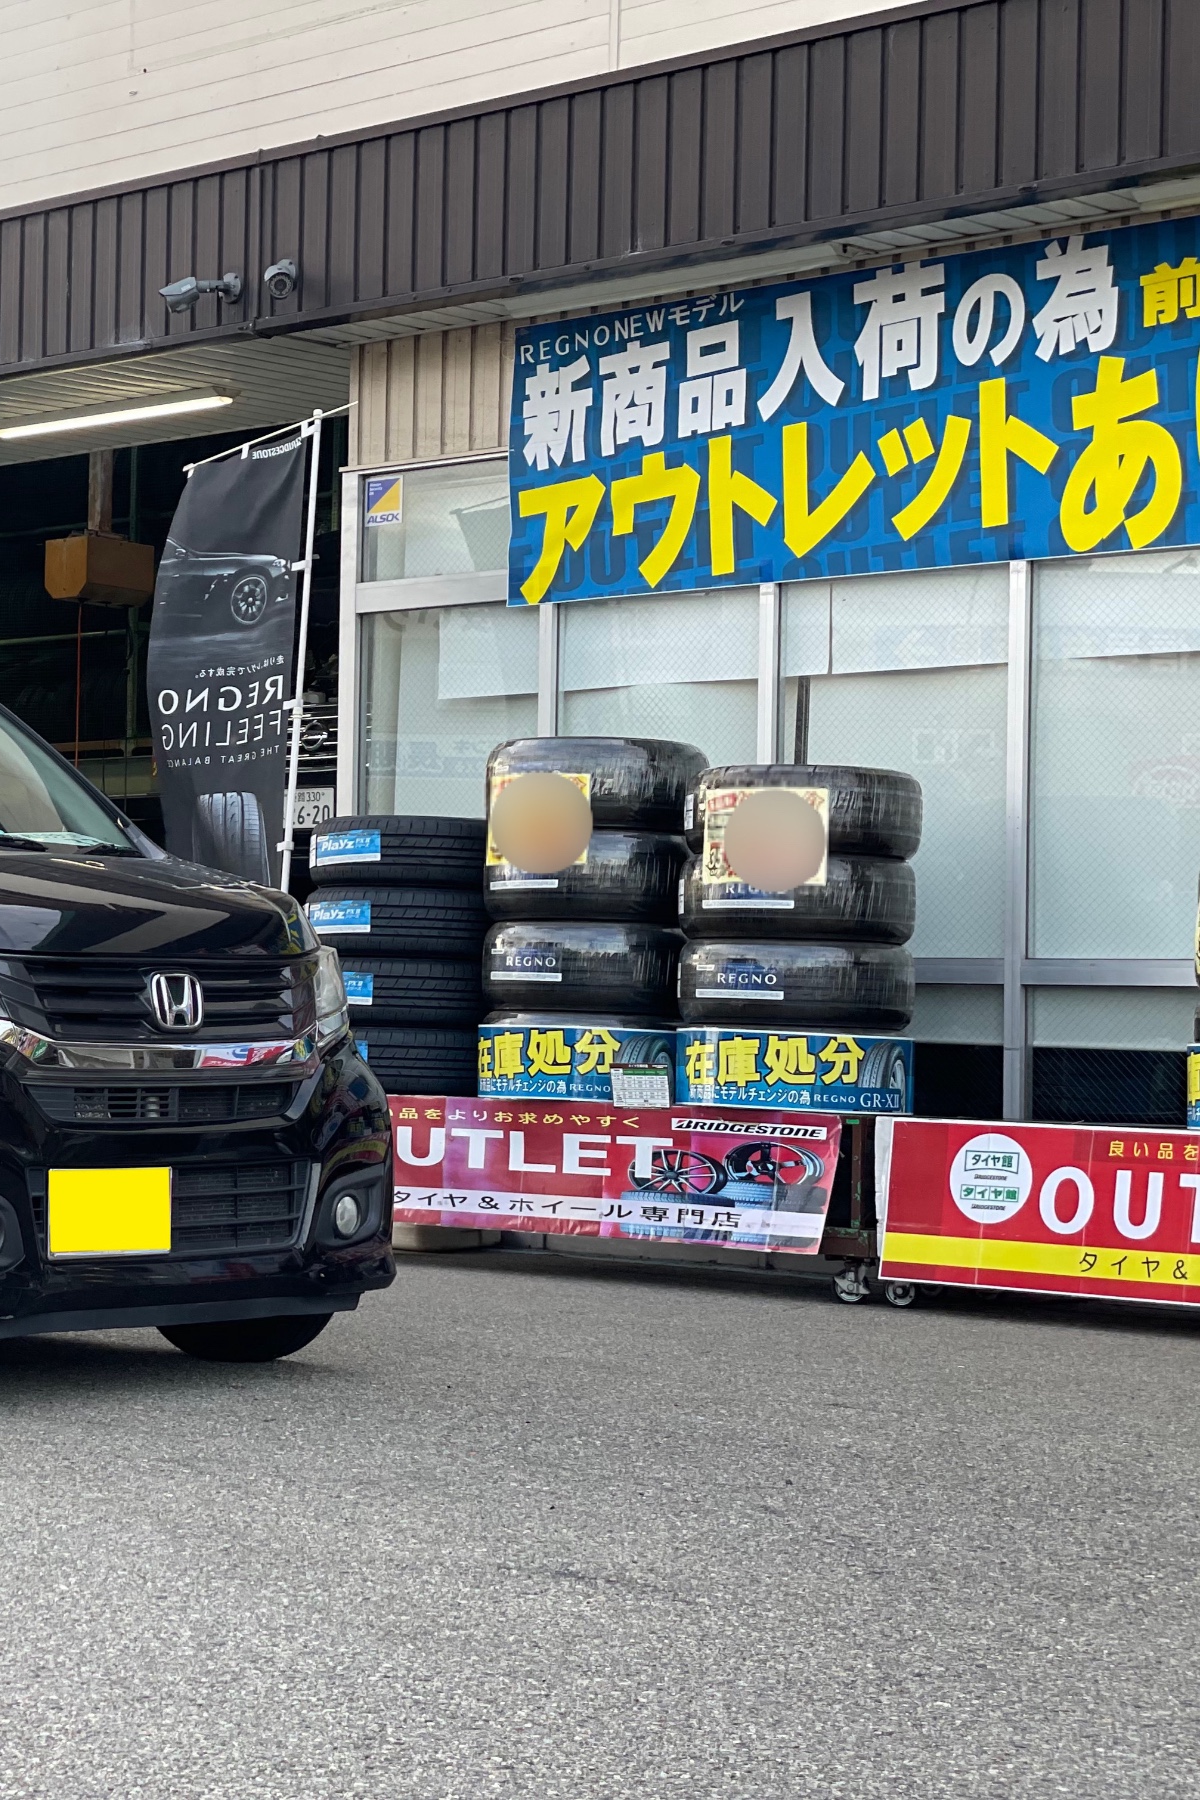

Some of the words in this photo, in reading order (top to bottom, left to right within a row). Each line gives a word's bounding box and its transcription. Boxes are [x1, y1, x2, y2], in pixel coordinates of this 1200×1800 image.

[521, 235, 1119, 471] 新商品入荷の為
[519, 345, 1200, 605] アウトレットあ
[367, 512, 400, 525] ALSOK
[306, 791, 320, 802] 330
[293, 804, 330, 825] 6-20
[505, 955, 557, 968] REGNO
[717, 972, 778, 985] REGNO
[478, 1029, 622, 1079] 在庫処分
[685, 1034, 866, 1087] 在庫処分
[569, 1083, 612, 1093] REGNO
[813, 1093, 856, 1104] REGNO
[388, 1107, 640, 1129] 品をよりお求めやすく
[674, 1118, 823, 1138] BRIDGESTONE
[396, 1125, 674, 1179] UTLET
[1108, 1139, 1199, 1161] 良い品を
[971, 1153, 1014, 1168] タイヤ館
[962, 1186, 1017, 1200] タイヤ館
